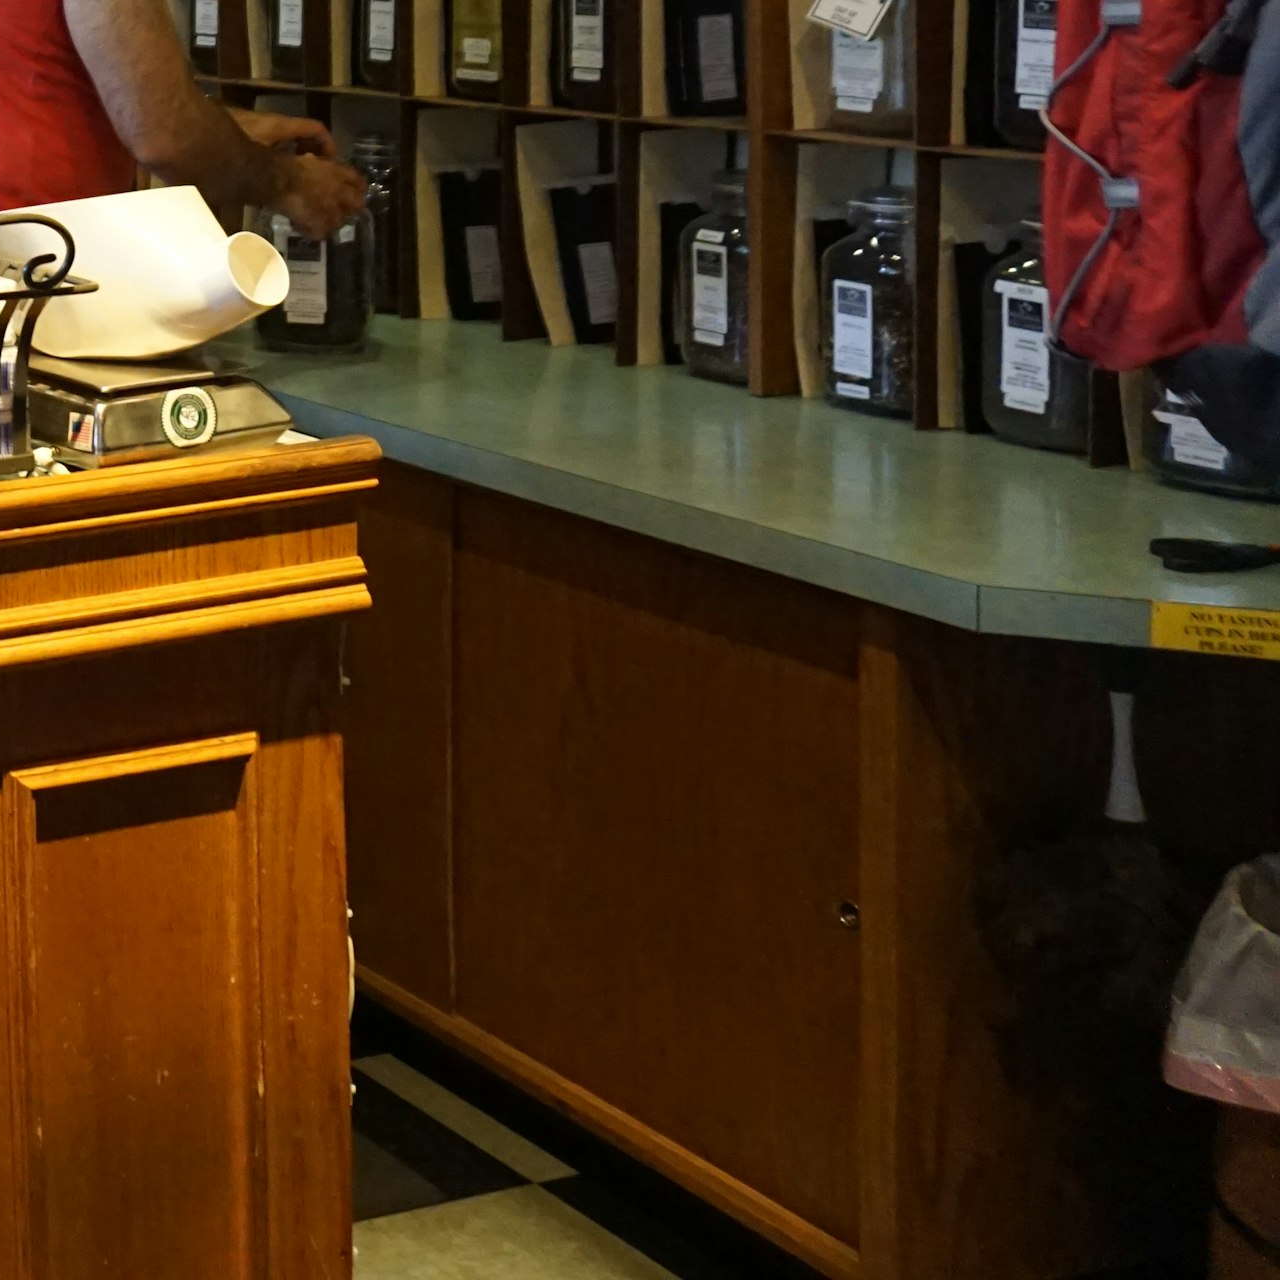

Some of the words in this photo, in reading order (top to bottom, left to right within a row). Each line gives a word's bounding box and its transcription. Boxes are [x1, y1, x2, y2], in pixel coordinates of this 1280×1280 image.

[1190, 612, 1213, 621] NO
[1183, 625, 1225, 637] CUPS
[1227, 628, 1244, 638] IN
[1248, 630, 1280, 642] HER
